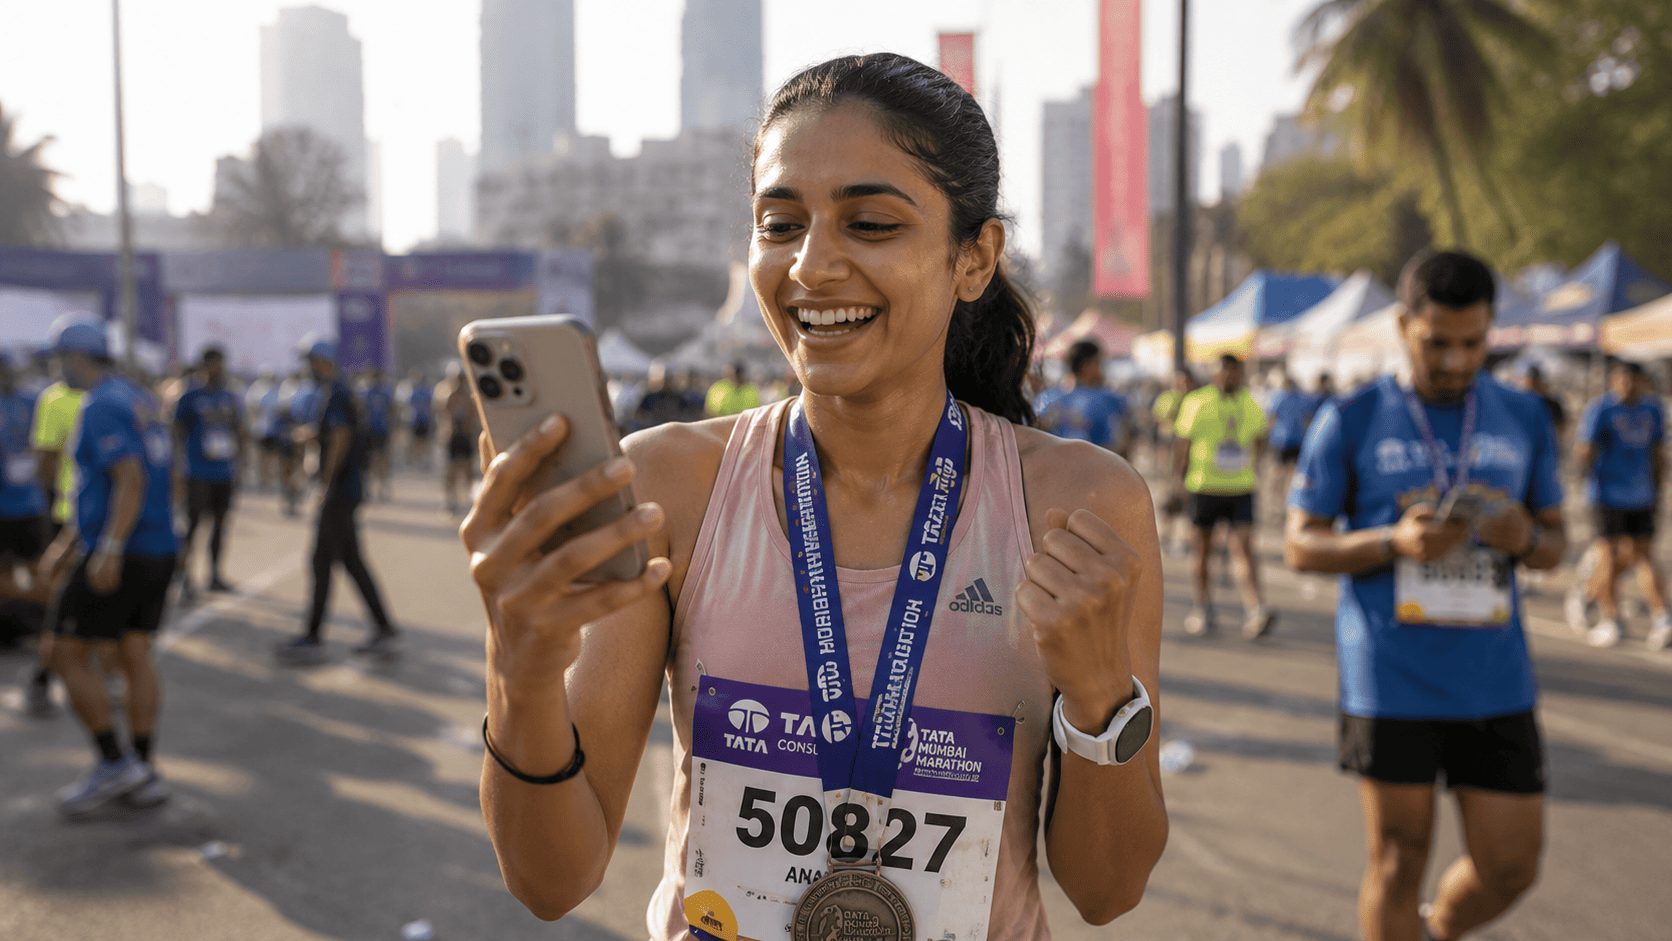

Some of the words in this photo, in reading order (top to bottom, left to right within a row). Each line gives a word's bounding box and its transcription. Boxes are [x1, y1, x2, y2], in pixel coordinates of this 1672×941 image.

[723, 733, 768, 754] TATA
[920, 729, 955, 745] TATA
[918, 742, 967, 759] MUMBAI
[915, 755, 982, 773] MARATHON
[735, 786, 967, 873] 50827
